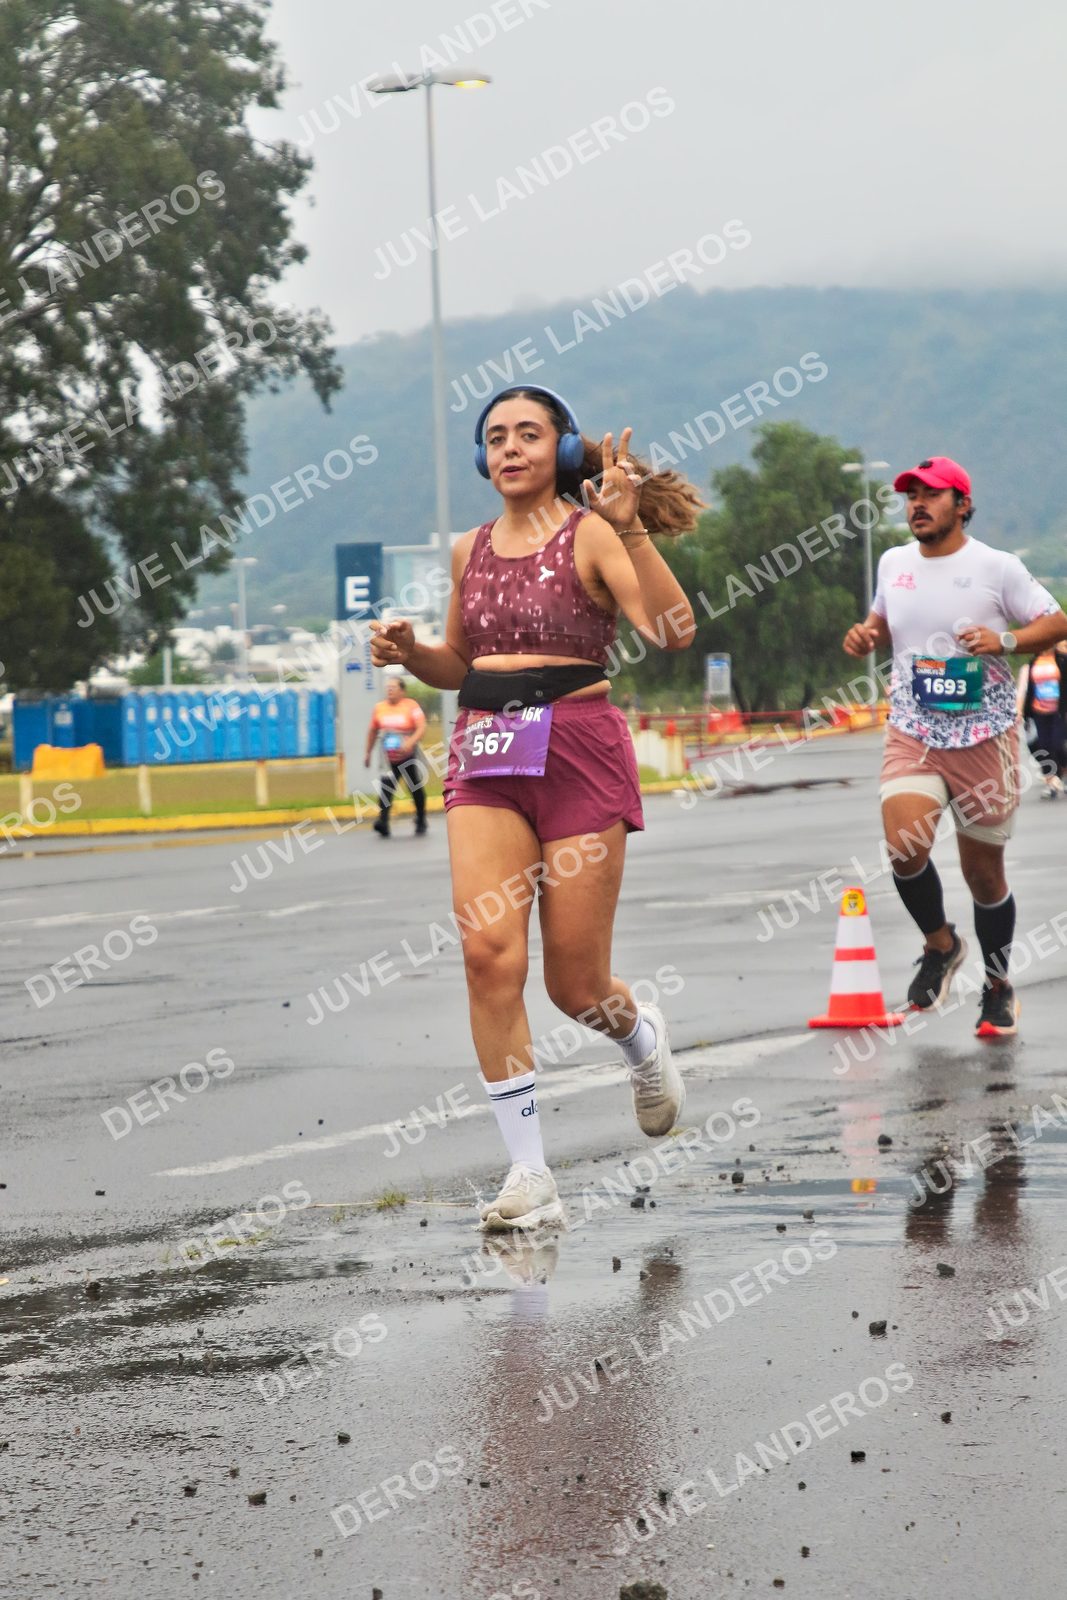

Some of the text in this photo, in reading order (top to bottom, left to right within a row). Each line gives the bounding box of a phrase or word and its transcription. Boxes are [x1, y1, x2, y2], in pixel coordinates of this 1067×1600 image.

[345, 575, 370, 612] E
[923, 676, 967, 695] 1693
[521, 706, 544, 722] 16K
[472, 732, 515, 757] 567
